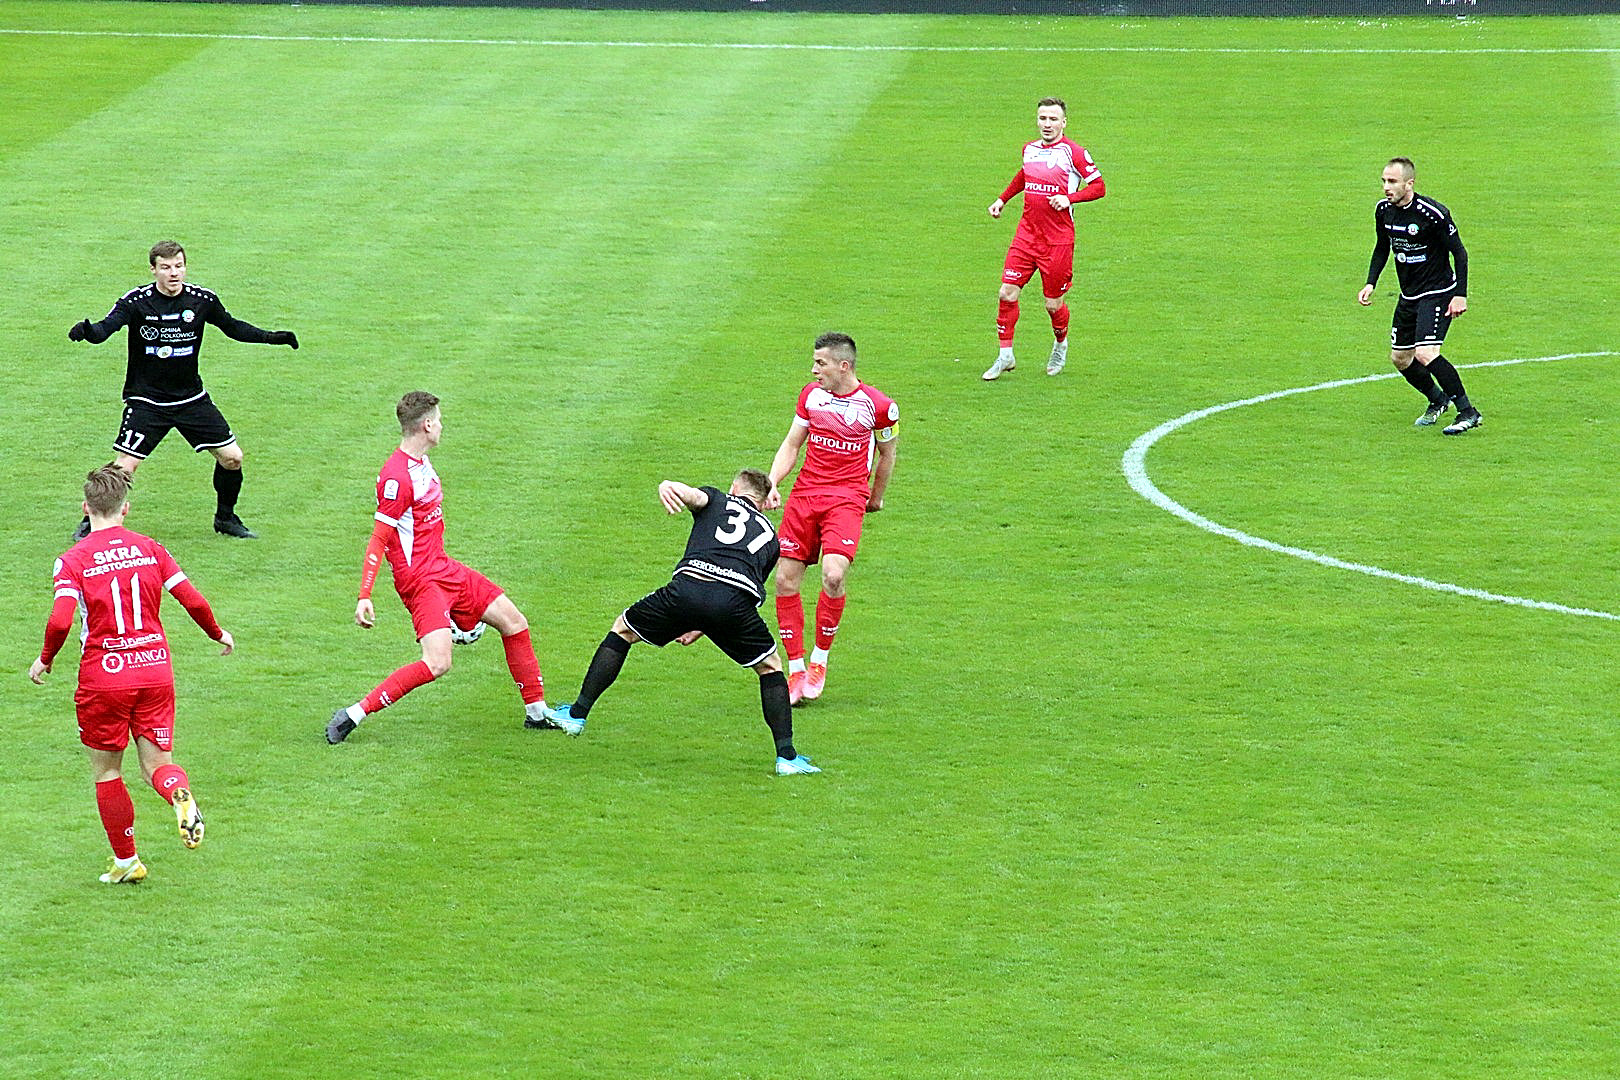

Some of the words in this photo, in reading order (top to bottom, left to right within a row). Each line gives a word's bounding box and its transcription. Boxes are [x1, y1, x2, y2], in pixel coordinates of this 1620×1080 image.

[121, 430, 145, 450] 17
[714, 501, 775, 555] 37
[93, 545, 143, 565] SKRA
[83, 556, 158, 577] CZĘSTOCHOWA
[110, 571, 143, 635] 11
[123, 648, 167, 664] TANGO
